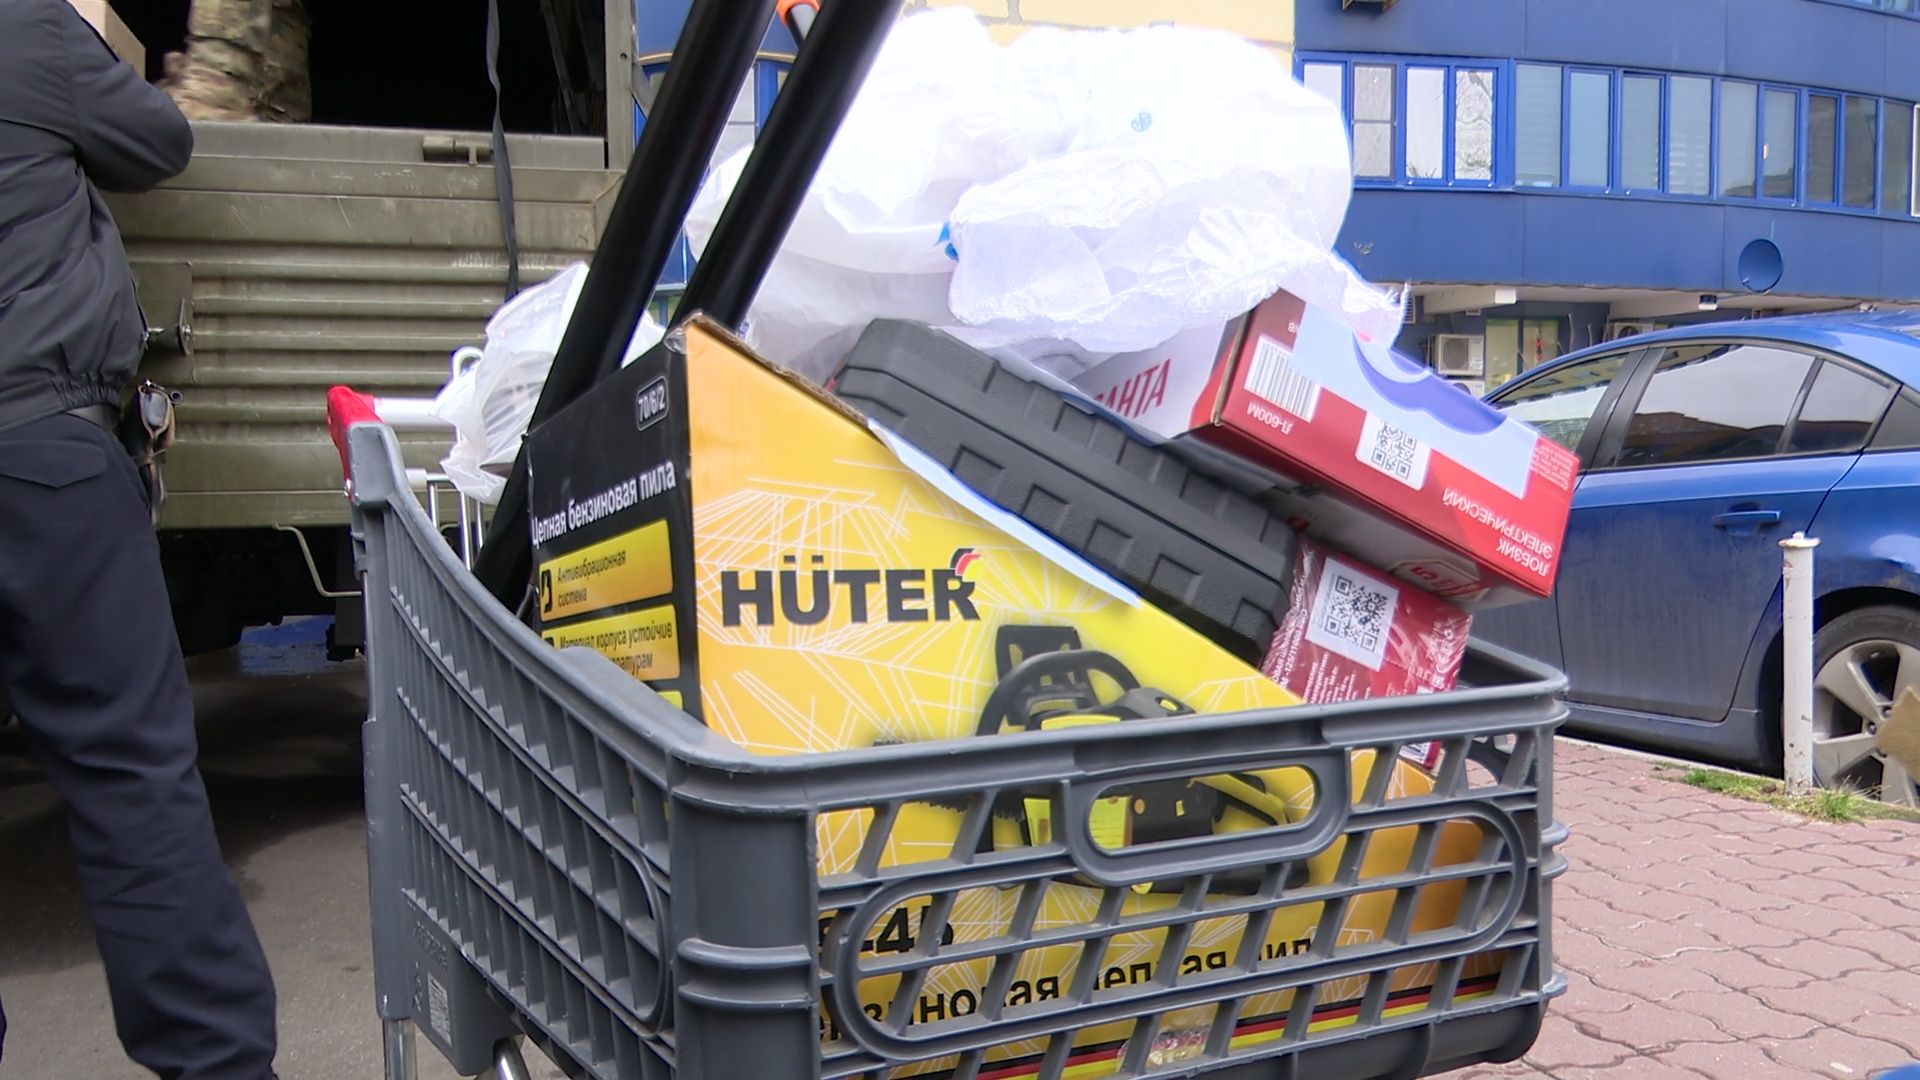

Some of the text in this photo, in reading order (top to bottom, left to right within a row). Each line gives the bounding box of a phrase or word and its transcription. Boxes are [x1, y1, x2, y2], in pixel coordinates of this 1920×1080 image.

[637, 385, 667, 420] 70/6/2
[1246, 402, 1294, 436] Л-600М
[531, 460, 677, 550] Цепная бензиновая пила
[1442, 487, 1554, 559] ЭЛЕКТРИЧЕСКИЙ
[1496, 538, 1550, 577] ЛОБЗИК
[557, 587, 588, 608] система
[720, 553, 982, 627] HÜTER
